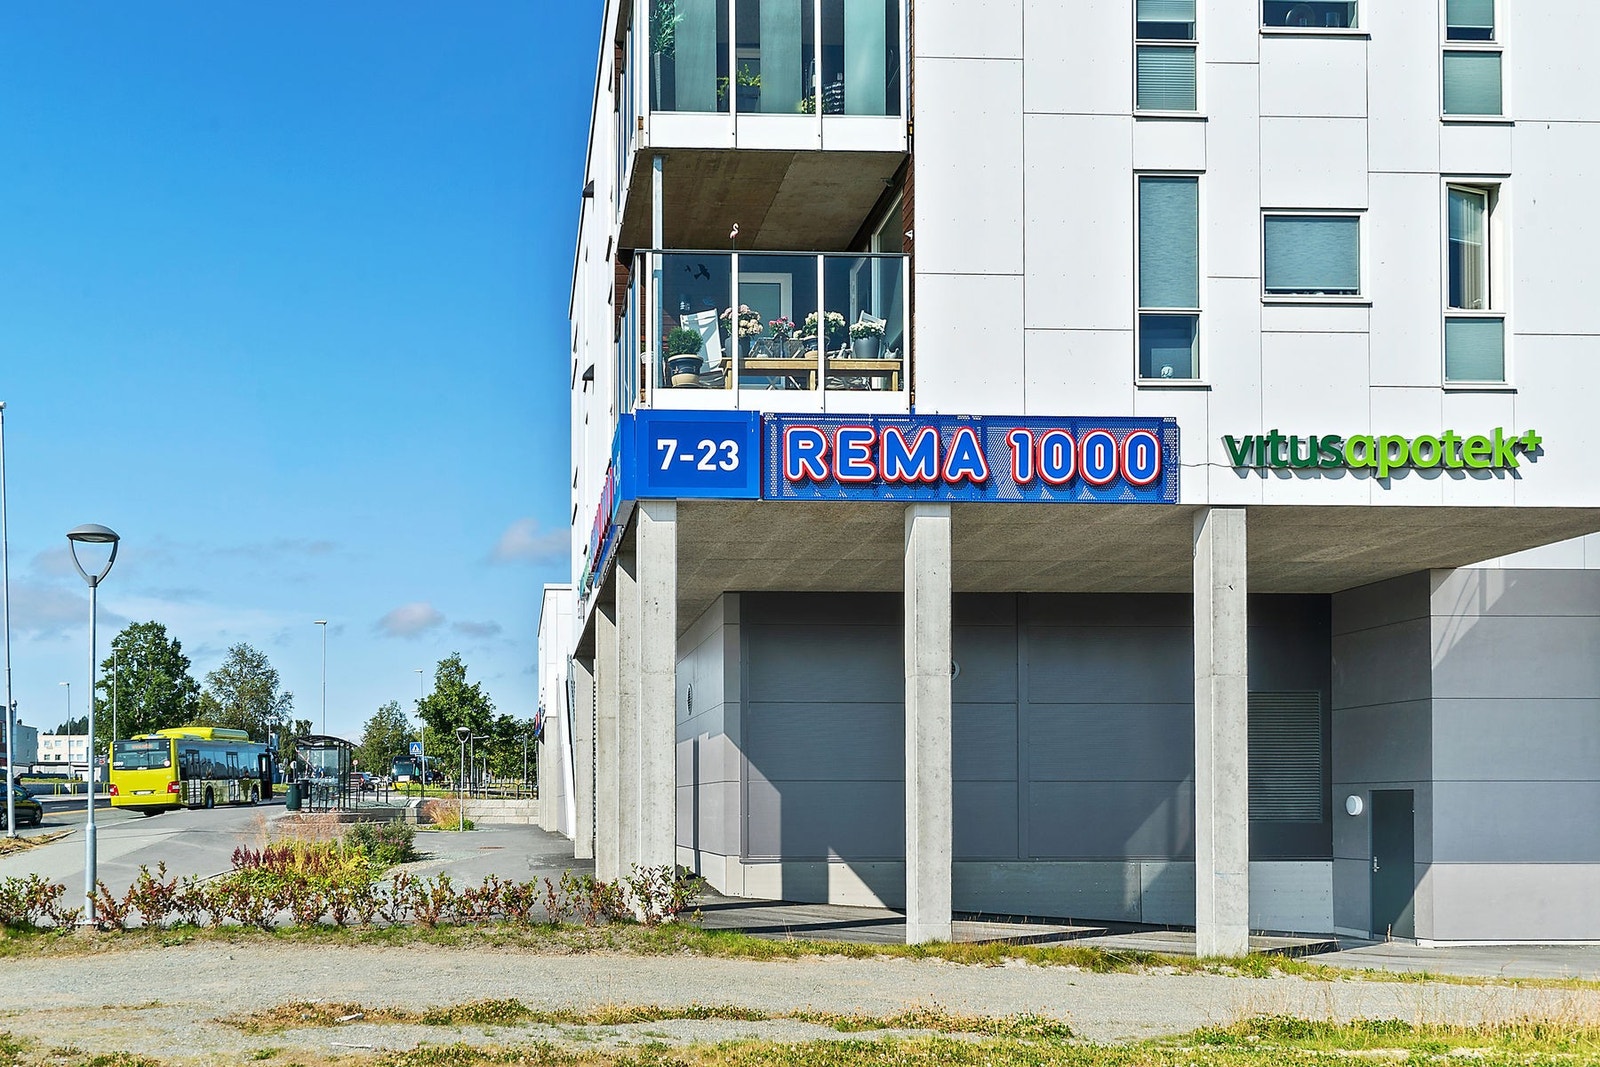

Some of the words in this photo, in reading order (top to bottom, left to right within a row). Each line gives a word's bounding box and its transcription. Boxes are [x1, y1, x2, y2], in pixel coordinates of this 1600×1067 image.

[657, 439, 740, 471] 7-23
[783, 425, 990, 484] REMA
[1006, 427, 1162, 485] 1000
